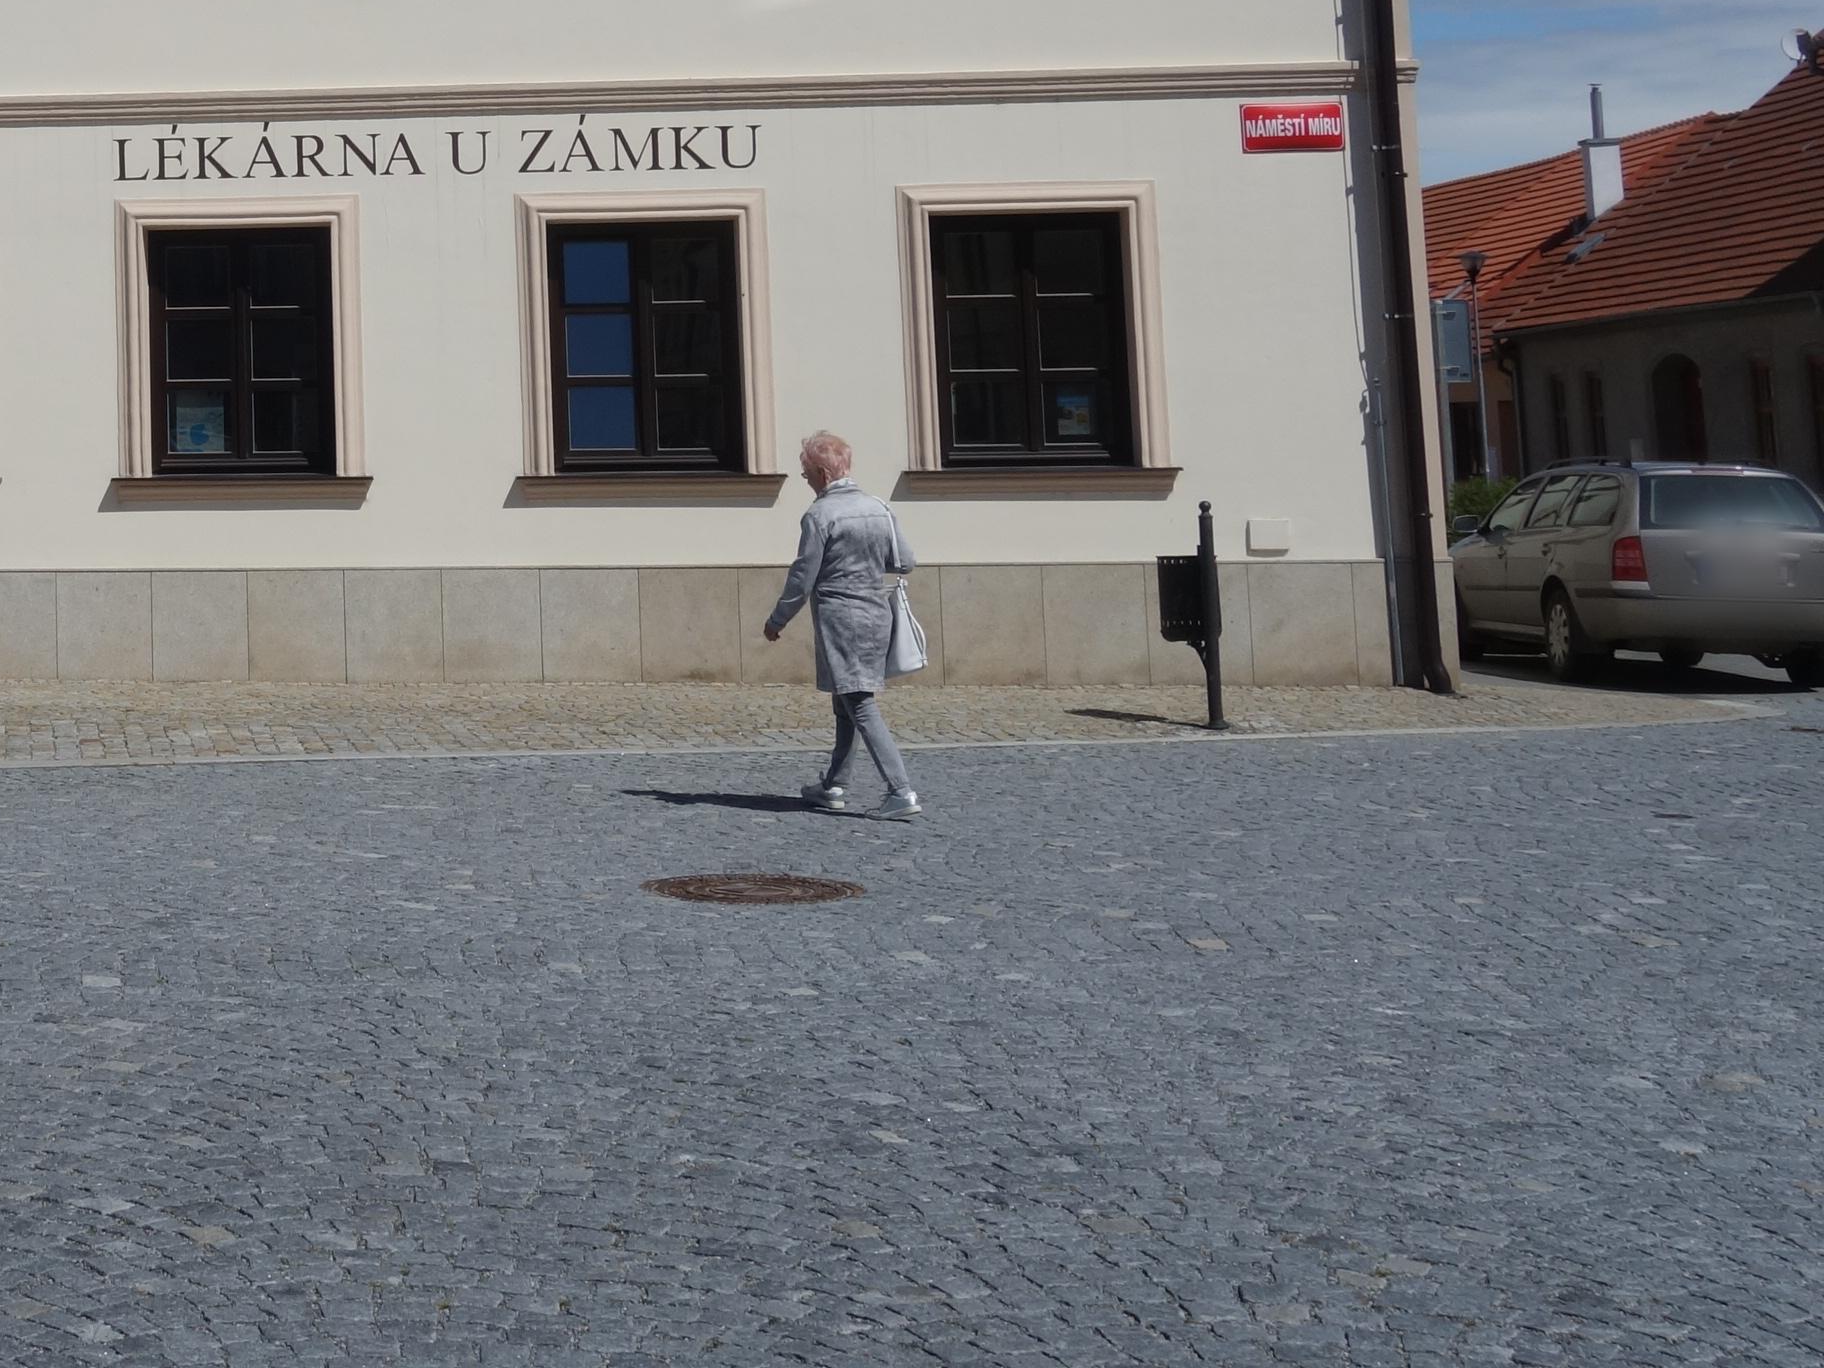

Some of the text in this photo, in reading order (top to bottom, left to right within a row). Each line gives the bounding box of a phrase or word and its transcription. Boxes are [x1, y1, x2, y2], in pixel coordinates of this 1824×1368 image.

[112, 114, 762, 182] LÉKÁRNA U ZÁMKU
[1245, 113, 1341, 138] NÁMĚSTÍ MÍRU
